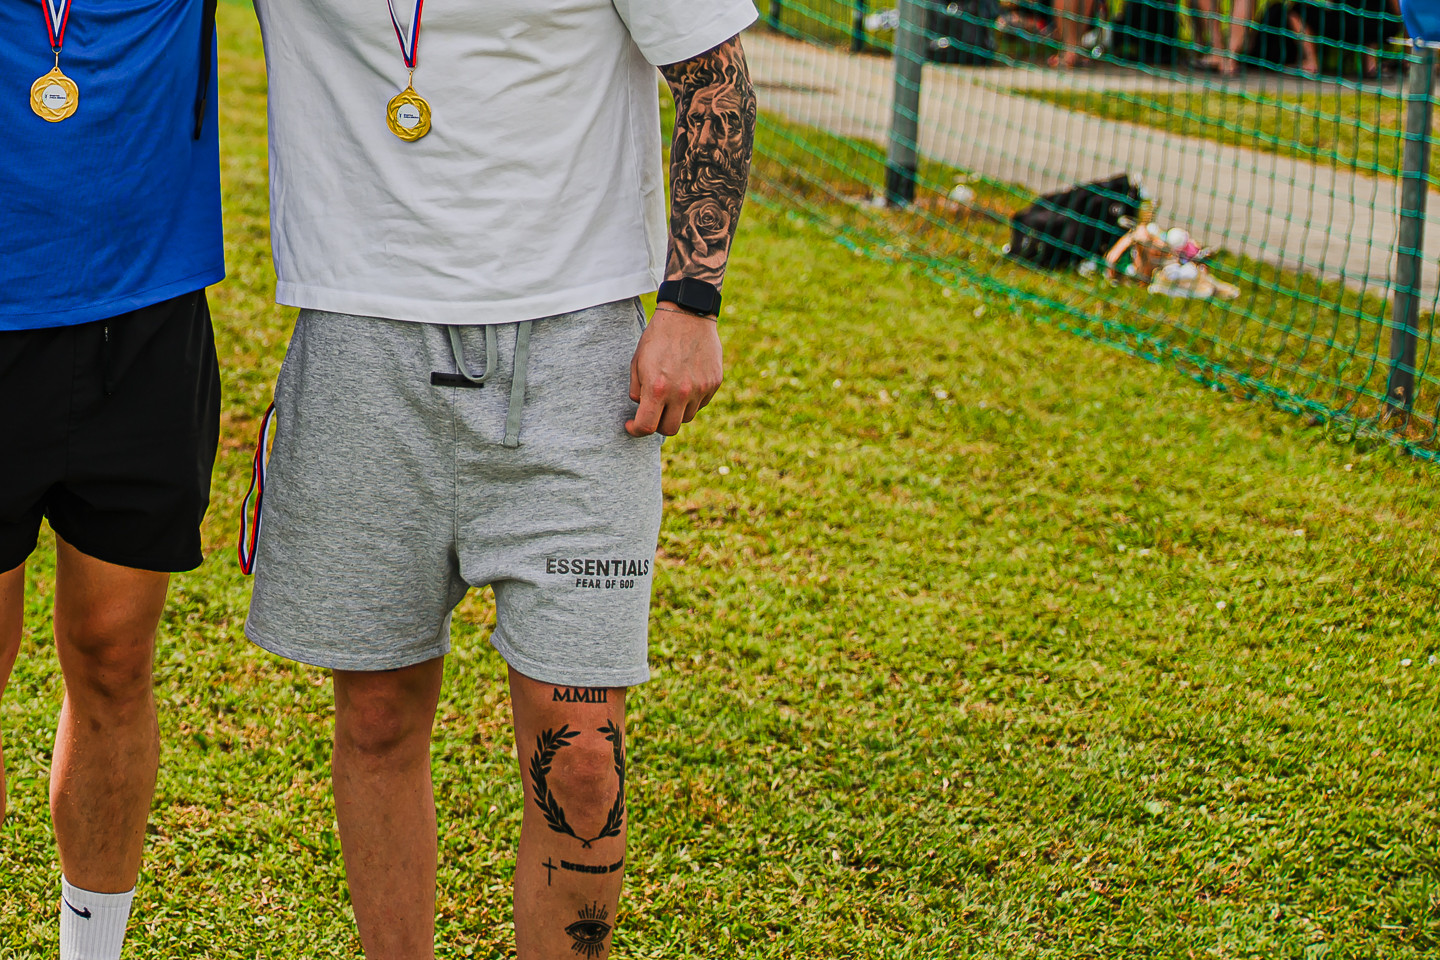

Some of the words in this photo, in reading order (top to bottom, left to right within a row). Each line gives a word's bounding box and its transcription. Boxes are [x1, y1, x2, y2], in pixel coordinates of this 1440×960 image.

[545, 558, 649, 576] ESSENTIALS
[575, 579, 600, 589] FEAR
[605, 580, 616, 589] OF
[620, 580, 634, 589] GOD
[552, 687, 608, 703] MMIII
